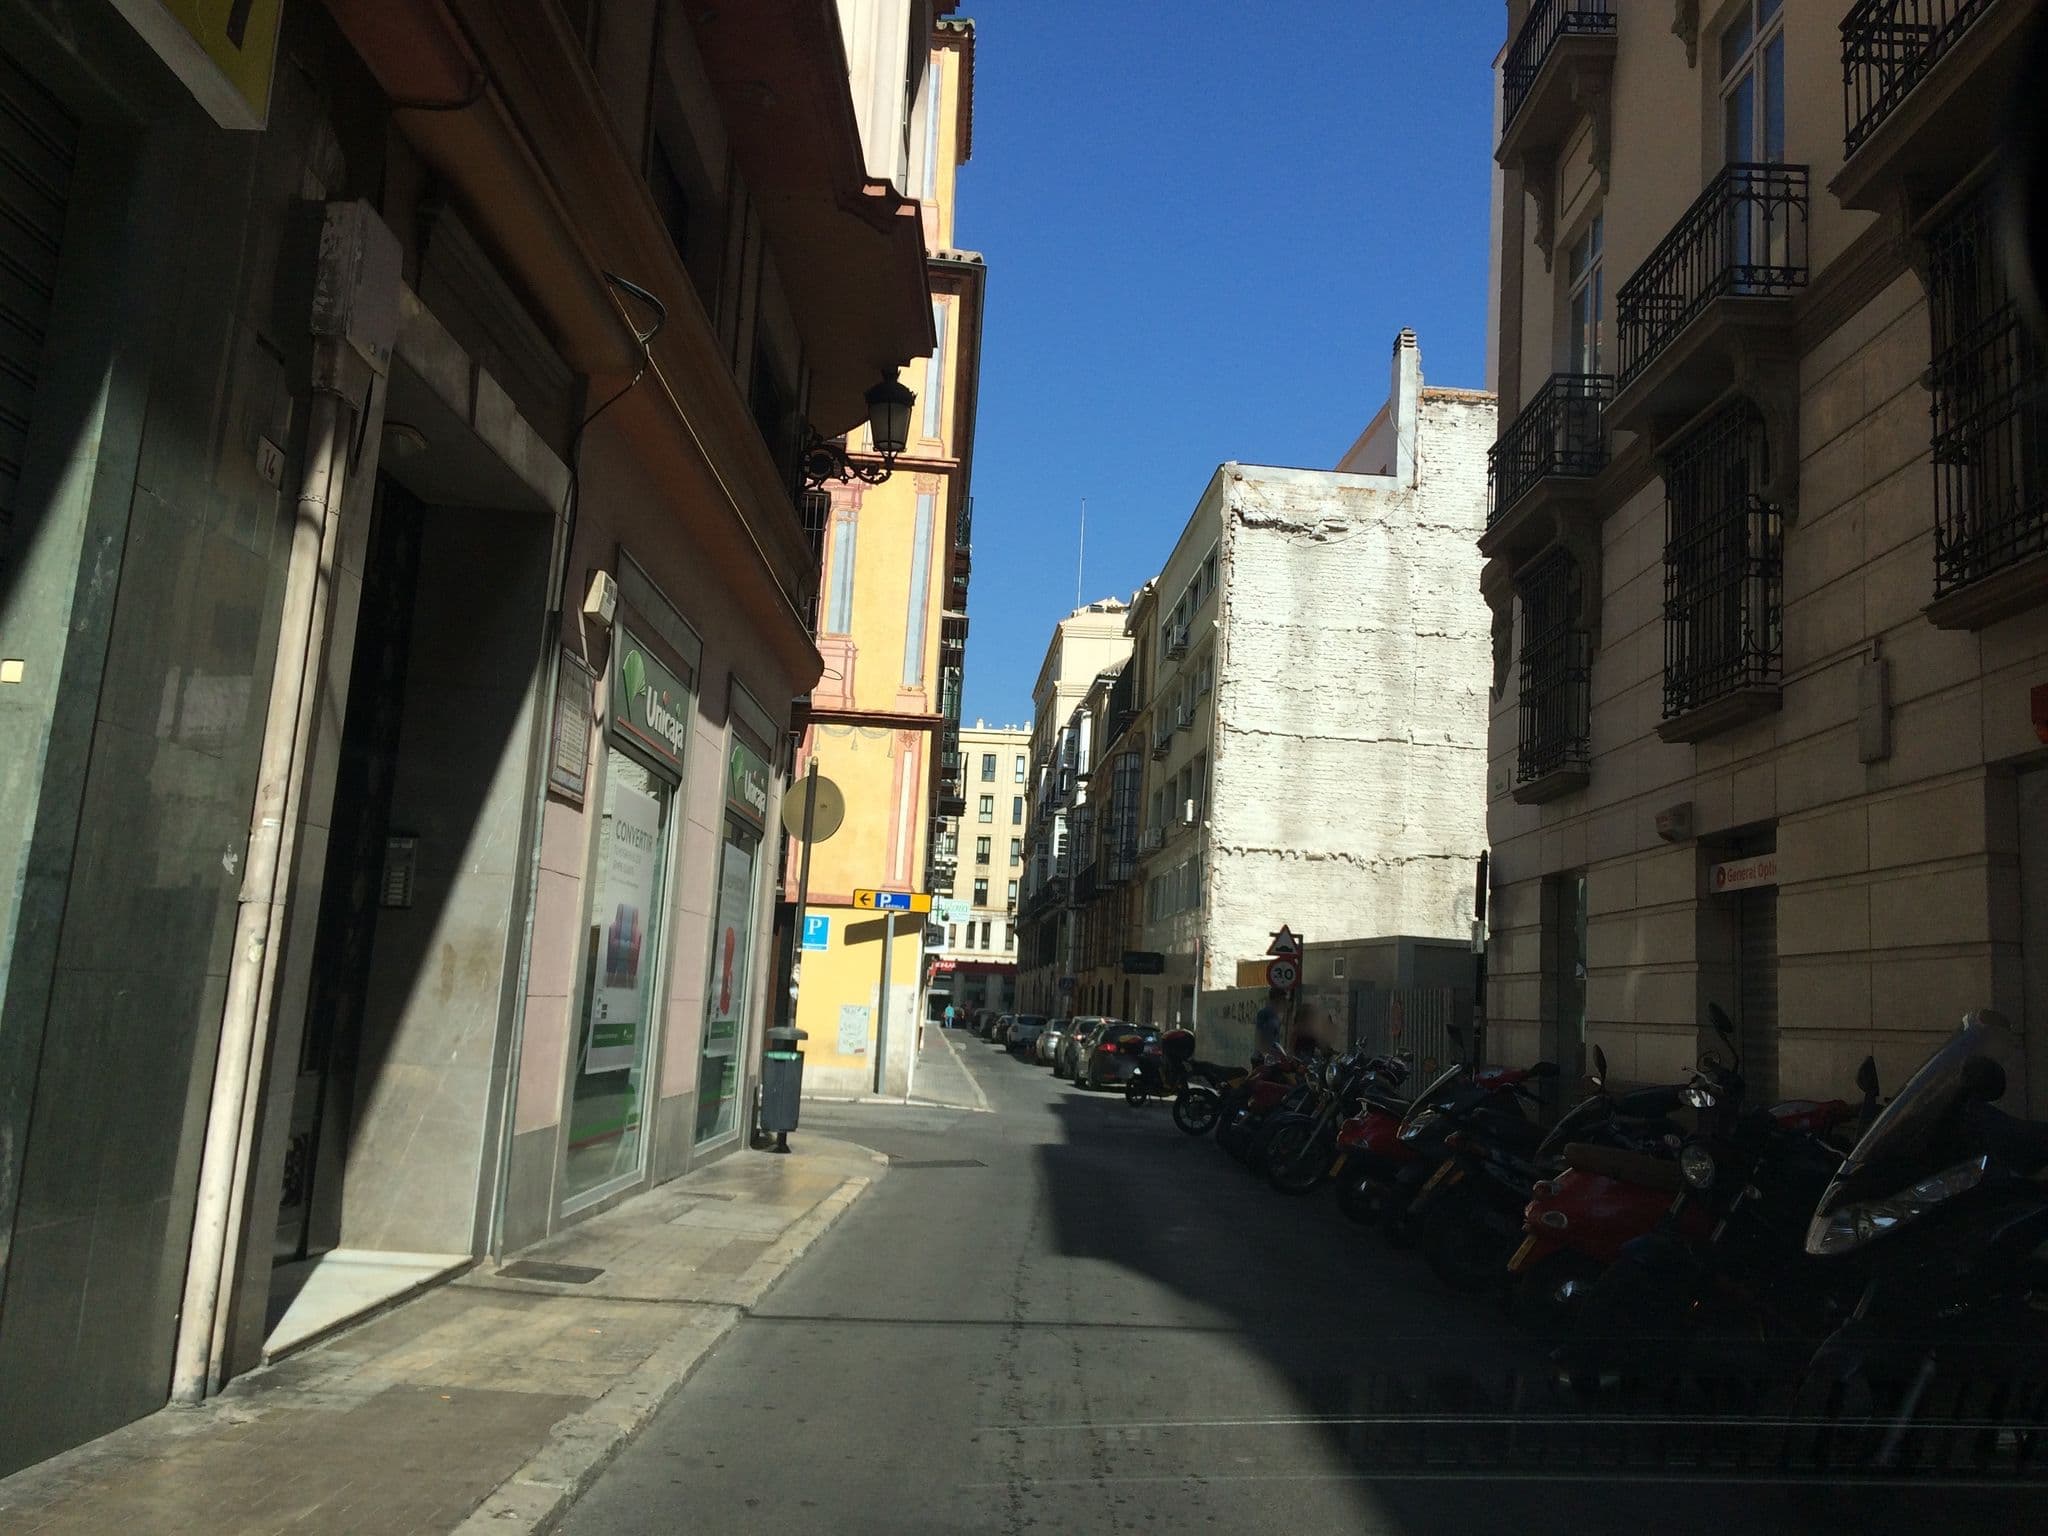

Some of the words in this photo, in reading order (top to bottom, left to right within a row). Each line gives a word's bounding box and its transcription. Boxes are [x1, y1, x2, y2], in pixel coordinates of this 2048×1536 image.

[264, 449, 276, 480] 14
[646, 685, 684, 755] Unicaja
[1727, 864, 1757, 882] General
[880, 893, 892, 908] P
[807, 918, 823, 935] P
[1273, 967, 1294, 981] 30
